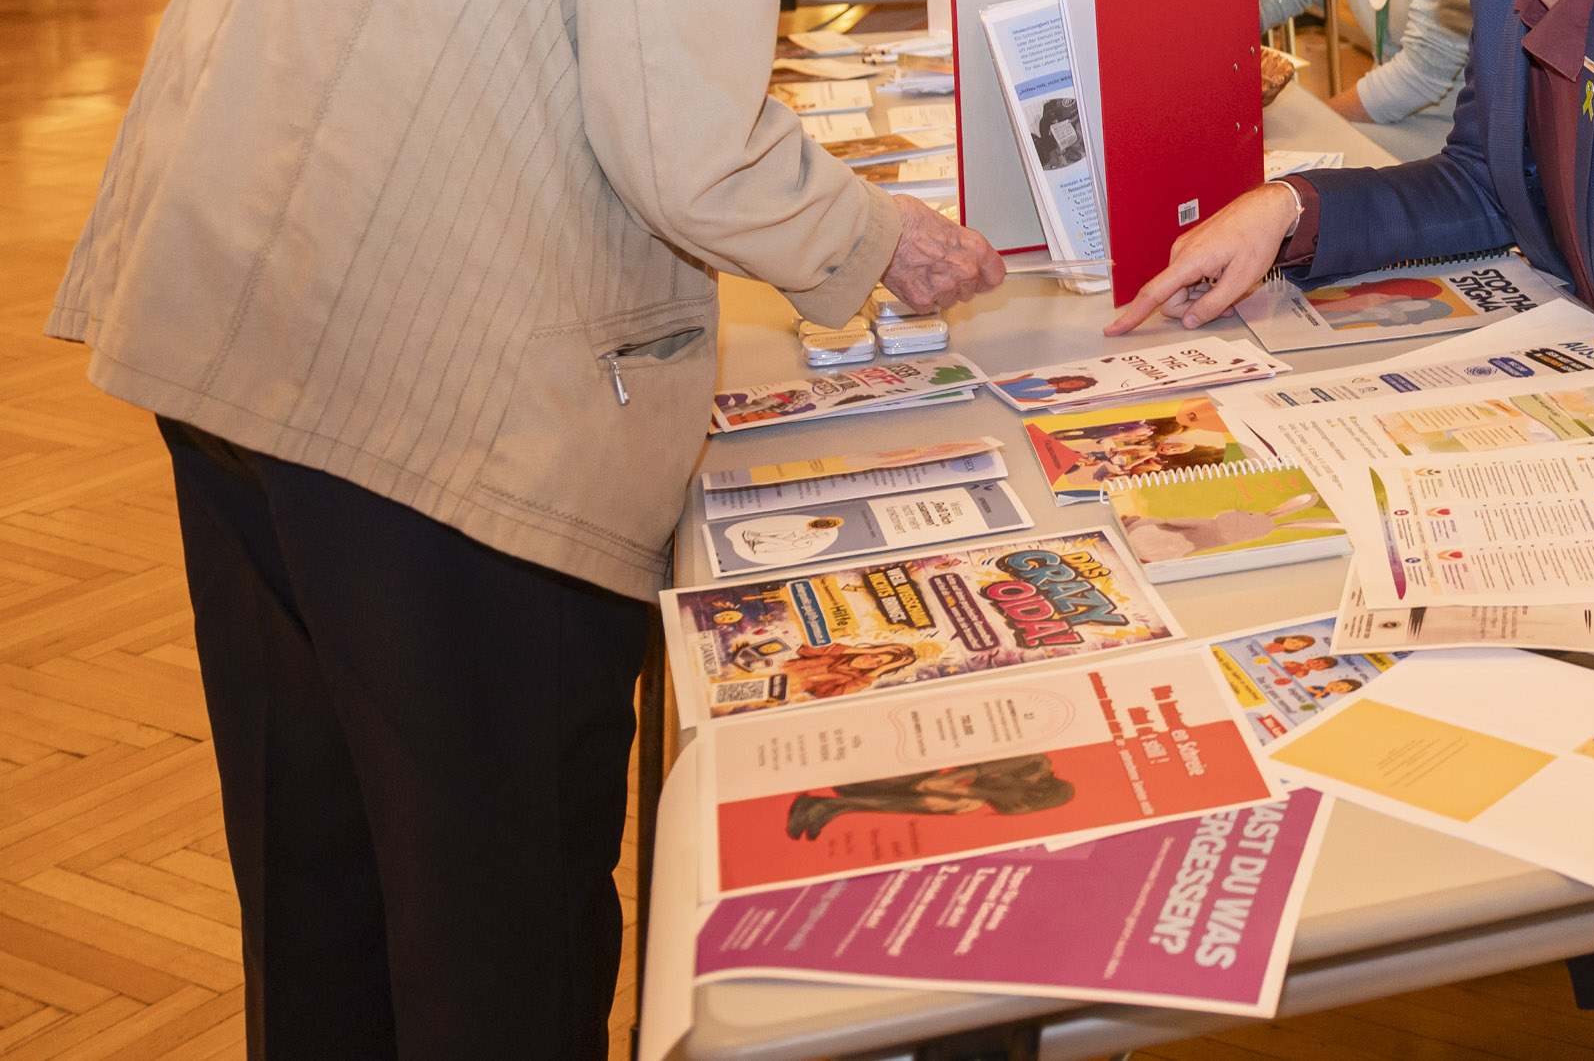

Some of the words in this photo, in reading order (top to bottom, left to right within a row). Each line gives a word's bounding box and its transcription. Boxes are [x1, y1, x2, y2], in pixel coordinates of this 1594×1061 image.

[1448, 275, 1508, 315] STIGMA
[1471, 268, 1513, 302] STOP
[1120, 353, 1169, 384] STIGMA
[1158, 354, 1190, 371] THE
[1178, 347, 1219, 367] STOP
[885, 564, 909, 586] WEIL
[1062, 551, 1112, 579] DAS
[867, 571, 896, 599] NICHTS
[1004, 551, 1130, 627] CRAZY
[829, 603, 849, 628] Hilfe
[984, 580, 1085, 647] OIDA!
[1225, 854, 1268, 900] DU
[1193, 897, 1253, 971] WAS
